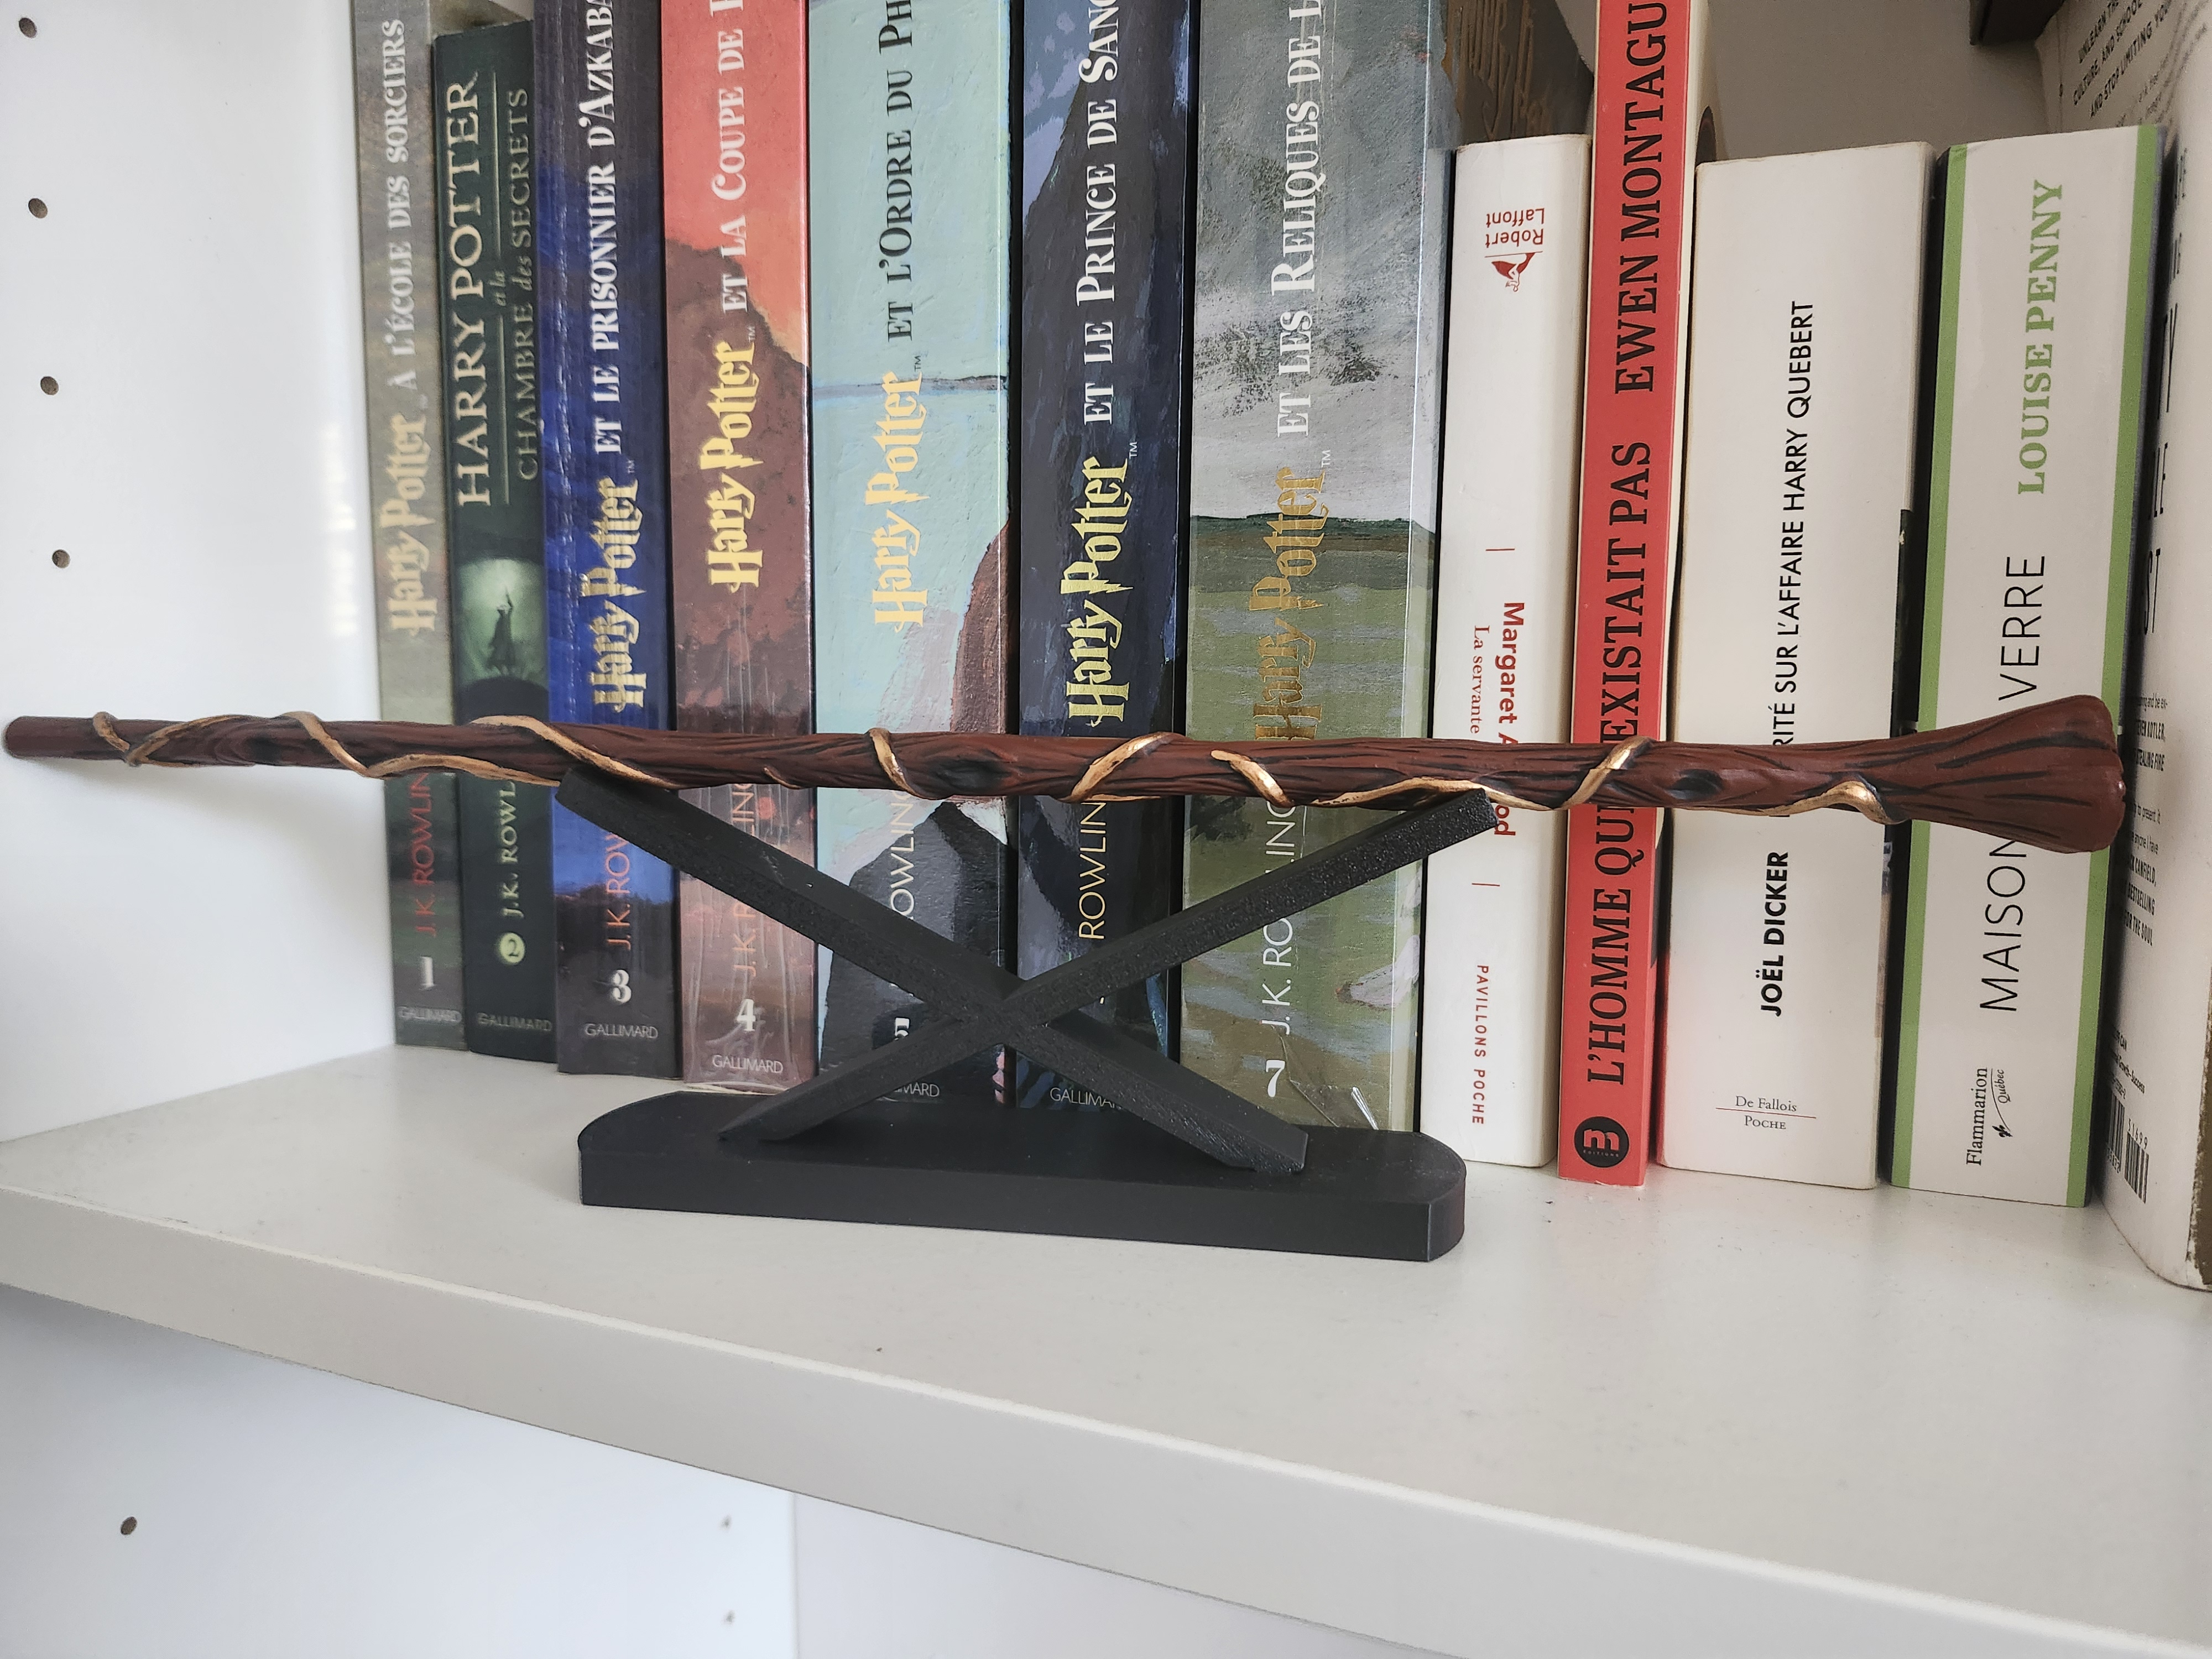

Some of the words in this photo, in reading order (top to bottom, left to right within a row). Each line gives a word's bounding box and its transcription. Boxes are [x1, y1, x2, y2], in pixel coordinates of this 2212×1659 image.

[718, 28, 744, 76] DE
[1078, 0, 1119, 83] SAN
[1287, 35, 1322, 89] DE
[2090, 93, 2103, 119] AND
[2104, 67, 2119, 100] STOP
[2120, 21, 2153, 75] LIMITING
[2102, 34, 2114, 64] AND
[383, 19, 409, 163] SORCIERS
[887, 69, 912, 117] DU
[1087, 98, 1118, 150] DE
[1621, 3, 1667, 241] MONTAGU
[447, 70, 483, 300] POTTER
[504, 87, 532, 249] SECRETS
[711, 86, 748, 200] COUPE
[388, 176, 411, 229] DES
[719, 215, 747, 259] LA
[879, 129, 913, 282] L'ORDRE
[1077, 163, 1117, 306] PRINCE
[1271, 100, 1326, 296] RELIQUES
[1485, 228, 1543, 248] Robert
[1486, 208, 1546, 226] Laffont
[385, 241, 415, 356] L'ÉCOLE
[510, 256, 532, 291] des
[587, 161, 619, 352] PRISONNIER
[722, 274, 748, 313] ET
[2025, 178, 2063, 333] PENNY
[887, 302, 913, 342] ET
[1084, 321, 1113, 366] LE
[1279, 310, 1312, 377] LES
[1615, 254, 1660, 394] EWEN
[1787, 301, 1814, 418] QUEBERT
[451, 314, 492, 507] HARRY
[512, 303, 538, 481] CHAMBRE
[593, 365, 622, 404] LE
[701, 341, 764, 470] Potter
[1084, 382, 1114, 426] ET
[1278, 393, 1311, 438] ET
[2018, 344, 2054, 494] LOUISE
[379, 412, 435, 528] Potter
[594, 418, 622, 455] ET
[865, 371, 930, 505] Potter
[1783, 428, 1808, 510] HARRY
[1061, 455, 1133, 595] Potter
[1609, 442, 1651, 526] PAS
[581, 476, 646, 598] Potter
[708, 473, 764, 592] Harry
[872, 510, 929, 633] Harry
[1250, 467, 1329, 612] Potter
[387, 530, 437, 637] Harry
[1776, 521, 1804, 639] L'AFFAIRE
[589, 600, 647, 713] Harry
[1066, 600, 1130, 727] Harry
[1473, 625, 1491, 650] La
[1495, 602, 1525, 724] Margaret
[1600, 538, 1646, 741] EXISTAIT
[1774, 645, 1798, 692] SUR
[1998, 555, 2046, 701] VERRE
[1253, 616, 1322, 740] Harry
[1469, 656, 1485, 734] servante
[1767, 703, 1795, 745] RITÉ
[410, 773, 434, 885] ROWLIN
[499, 781, 518, 864] ROWL
[890, 791, 914, 920] OWLIN
[1594, 805, 1644, 876] QUI
[1079, 802, 1106, 939] ROWLIN
[1764, 852, 1788, 946] DICKER
[2128, 883, 2155, 915] BESTSELLING
[1979, 841, 2027, 1013] MAISON
[419, 956, 436, 990] 1
[613, 969, 632, 1004] 3
[737, 999, 756, 1031] 4
[1473, 964, 1489, 1057] PAVILLONS
[1588, 888, 1631, 1087] L'HOMME
[1756, 953, 1784, 1017] JOËL
[477, 1012, 552, 1031] GALLIMARD
[585, 1023, 658, 1039] GALLIMARD
[712, 1055, 783, 1073] GALLIMARD
[1051, 1088, 1115, 1108] GALLIMA
[1265, 1060, 1286, 1097] 7
[1472, 1069, 1486, 1125] POCHE
[1735, 1095, 1754, 1109] De
[1758, 1097, 1797, 1113] Fallois
[1965, 1067, 1987, 1166] Flammarion
[1996, 1068, 2007, 1104] Québec
[1744, 1116, 1787, 1130] POCHE
